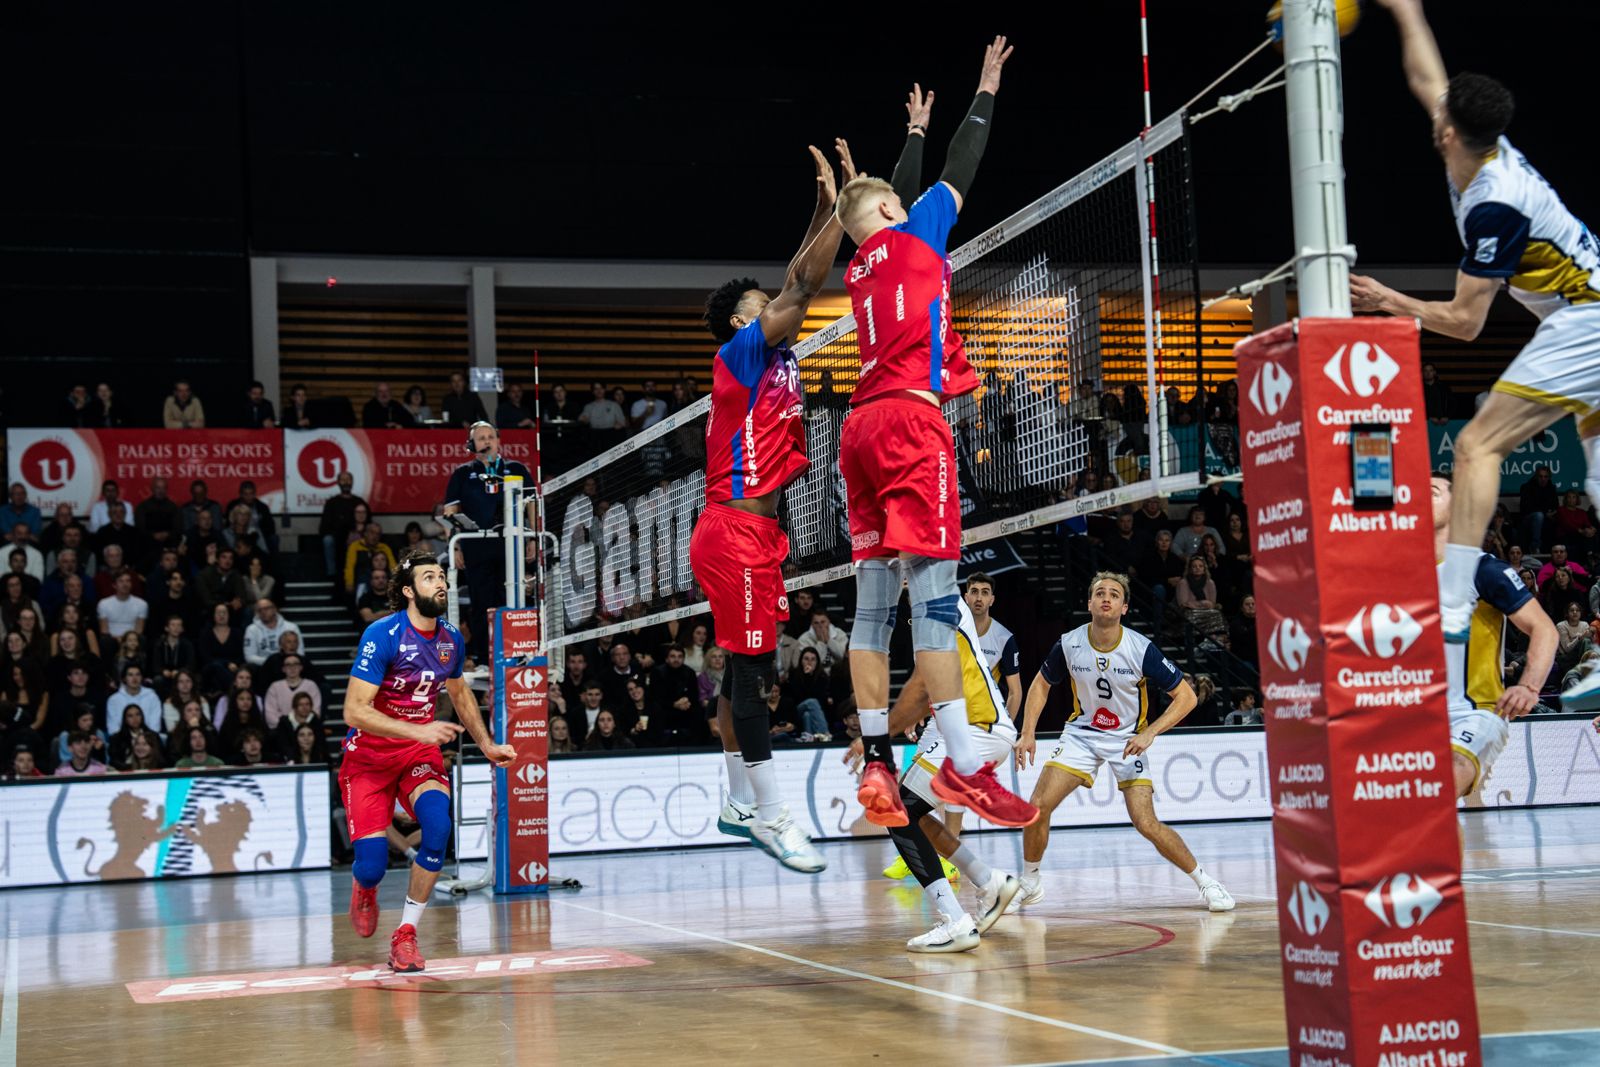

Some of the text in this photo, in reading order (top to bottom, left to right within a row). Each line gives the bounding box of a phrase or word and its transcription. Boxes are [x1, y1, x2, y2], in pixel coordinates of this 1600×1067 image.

[1091, 157, 1118, 187] CORSE
[977, 227, 1005, 255] CORSICA
[864, 295, 876, 345] 1
[1317, 404, 1413, 425] Carrefour
[1246, 421, 1301, 448] Carrefour
[118, 443, 272, 458] PALAIS DES SPORTS
[387, 443, 437, 458] PALAIS
[1255, 442, 1295, 466] market
[118, 462, 274, 478] ET DES SPECTACLES
[387, 463, 403, 477] ET
[410, 463, 438, 477] DES
[938, 451, 947, 503] LUCCIONI
[1257, 499, 1303, 526] AJACCIO
[1329, 512, 1418, 532] Albert 1er
[939, 527, 946, 549] 1
[1258, 526, 1308, 551] Albert 1er
[744, 568, 752, 611] LUCCIONI
[513, 641, 538, 649] AJACCI
[745, 630, 762, 648] 16
[413, 670, 435, 696] 6
[1337, 664, 1434, 688] Carrefour
[511, 691, 547, 699] Carrefour
[1096, 677, 1112, 700] 9
[1265, 679, 1321, 700] Carrefour
[1355, 688, 1424, 707] market
[1275, 702, 1312, 720] market
[513, 730, 536, 738] Albert
[515, 720, 546, 728] AJACCIO
[1459, 730, 1474, 744] 5
[925, 742, 939, 754] 3
[1134, 760, 1144, 773] 9
[1355, 751, 1436, 774] AJACCIO
[1278, 764, 1324, 783] AJACCIO
[513, 786, 547, 795] Carrefou
[1353, 778, 1443, 801] Albert 1er
[1279, 791, 1329, 809] Albert 1er
[516, 828, 538, 836] Albert
[1285, 943, 1339, 966] Carrefour
[1357, 935, 1454, 960] Carrefour
[1294, 968, 1333, 987] market
[1374, 958, 1443, 981] market
[1299, 1025, 1346, 1049] AJACCIO
[1379, 1019, 1460, 1045] AJACCIO
[1300, 1053, 1333, 1067] Albert
[1378, 1049, 1467, 1067] Albert 1er
